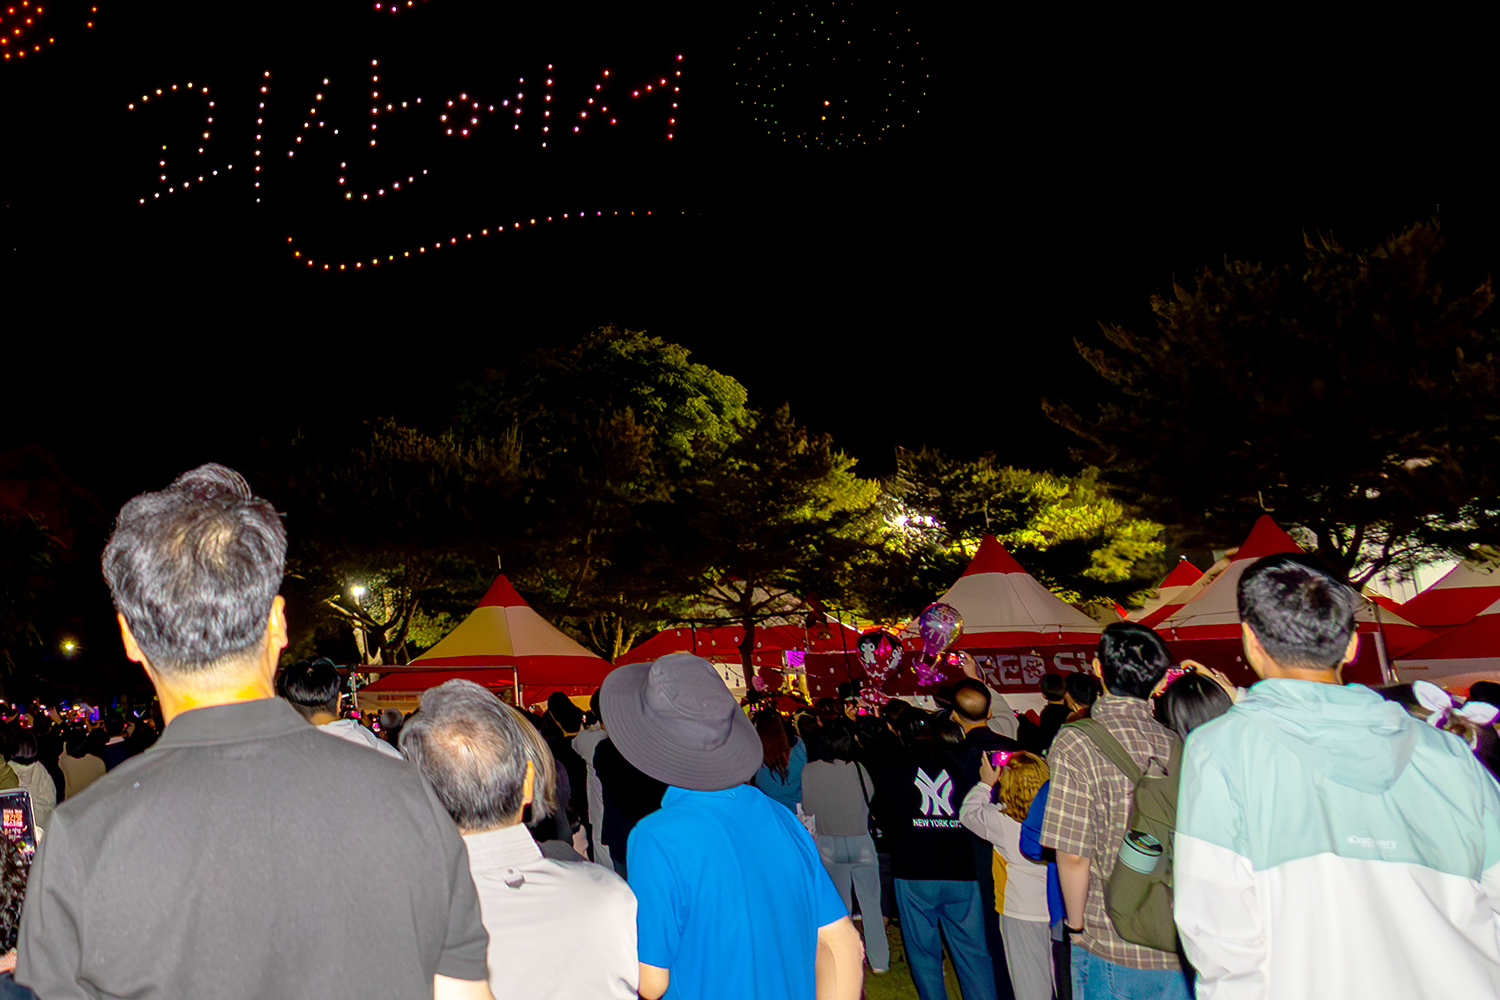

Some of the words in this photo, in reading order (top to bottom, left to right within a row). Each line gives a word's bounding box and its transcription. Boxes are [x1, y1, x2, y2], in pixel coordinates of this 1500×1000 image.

[912, 818, 930, 828] NEW
[930, 818, 949, 829] YORK
[949, 819, 962, 829] CIT
